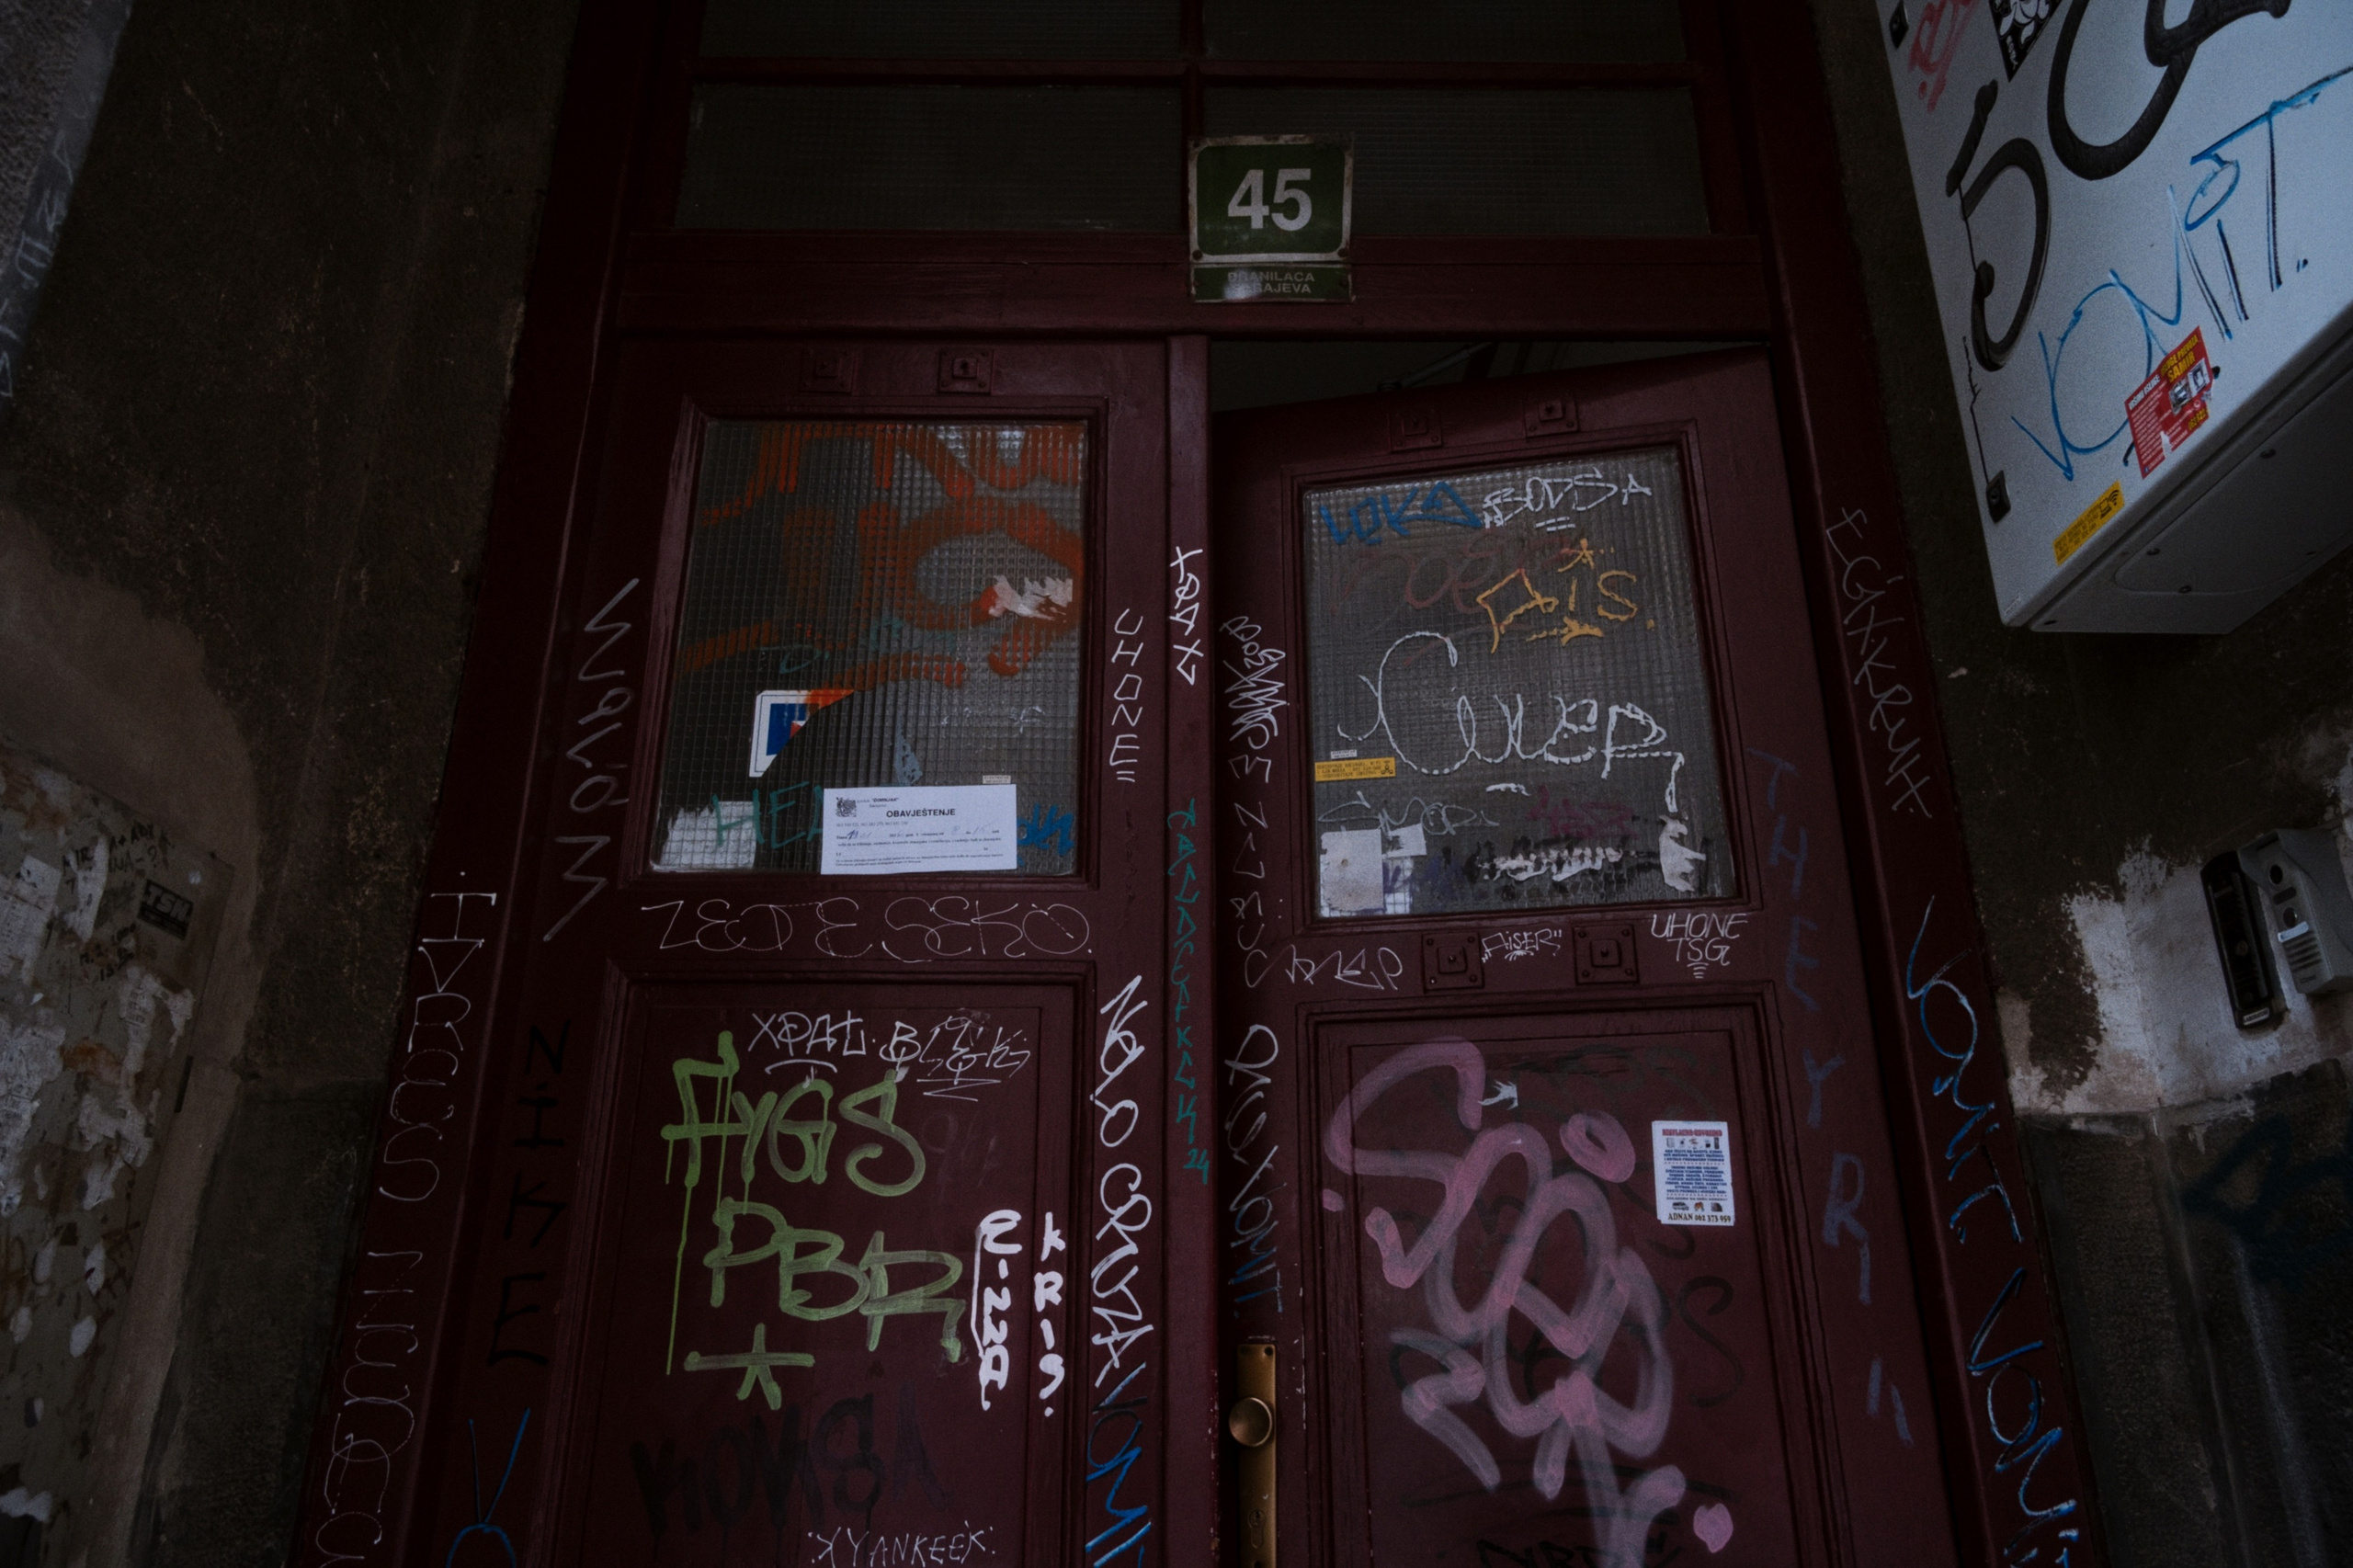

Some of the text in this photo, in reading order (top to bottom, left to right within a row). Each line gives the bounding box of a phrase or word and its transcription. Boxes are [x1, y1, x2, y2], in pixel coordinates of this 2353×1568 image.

[1227, 168, 1313, 232] 45
[2167, 351, 2196, 383] SAMIR
[886, 808, 956, 818] OBAVJEŠTENJE
[1651, 913, 1748, 938] UHONE
[703, 1199, 966, 1362] PBR
